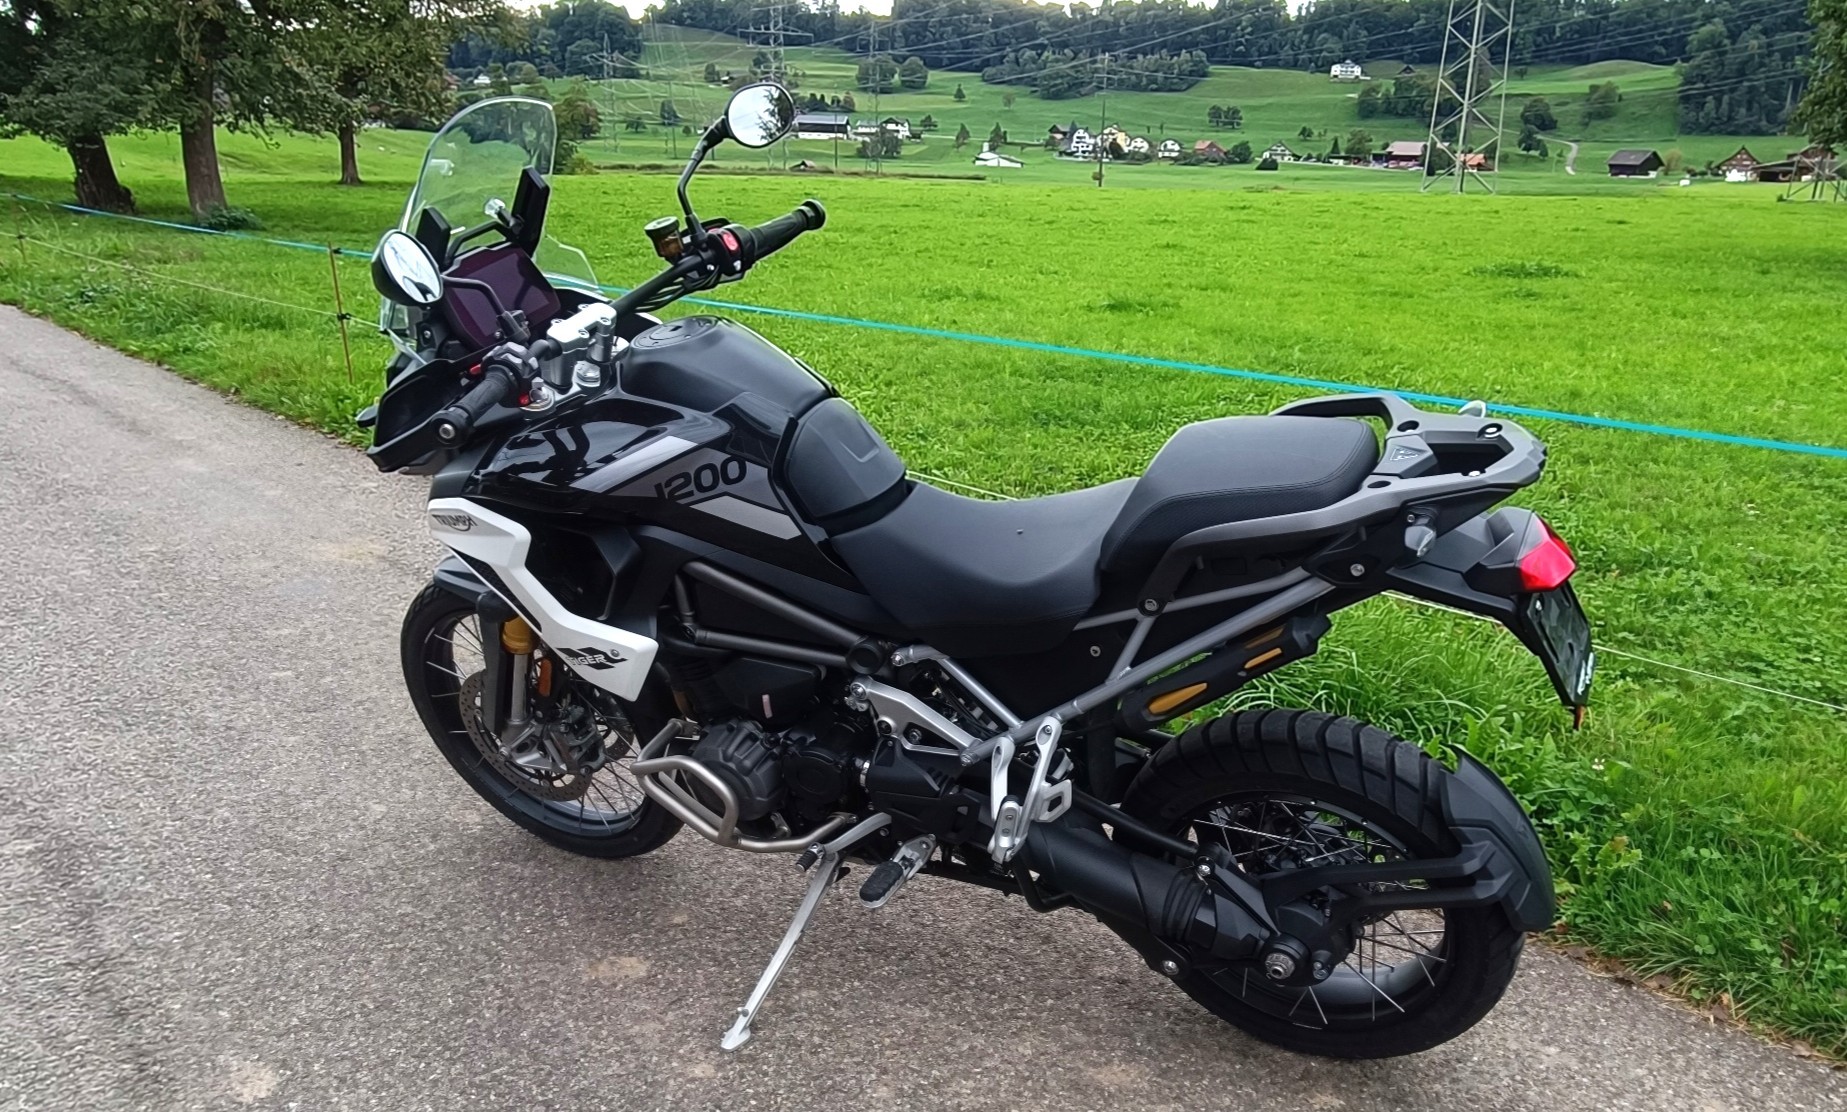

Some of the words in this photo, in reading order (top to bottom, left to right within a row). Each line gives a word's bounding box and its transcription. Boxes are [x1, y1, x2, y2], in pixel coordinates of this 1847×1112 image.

[654, 456, 747, 502] 1200
[431, 514, 478, 532] TRIUMPH
[566, 653, 607, 666] TIGER
